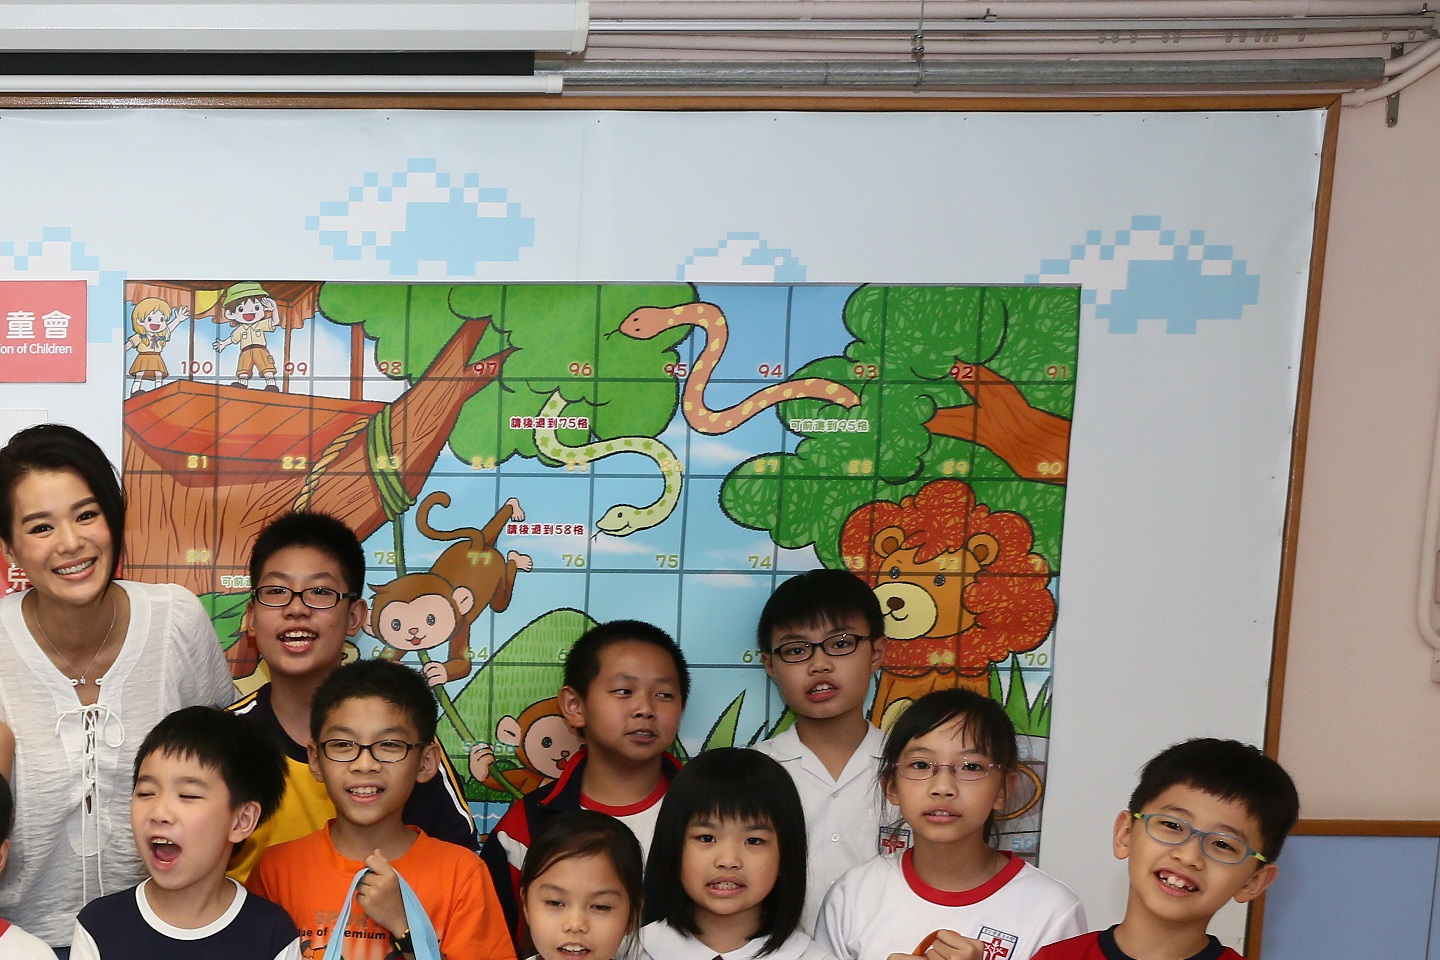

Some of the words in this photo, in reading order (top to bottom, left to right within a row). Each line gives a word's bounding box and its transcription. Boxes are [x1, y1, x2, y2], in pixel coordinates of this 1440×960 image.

[16, 342, 28, 354] of
[29, 342, 72, 354] Children
[181, 361, 213, 375] 100
[285, 361, 308, 375] 99
[378, 361, 402, 375] 98
[474, 362, 497, 376] 97
[569, 362, 593, 376] 96
[664, 363, 688, 377] 95
[759, 364, 782, 377] 94
[854, 364, 878, 378] 93
[949, 365, 973, 379] 92
[1047, 365, 1068, 379] 91
[510, 417, 589, 429] 請後退到75格
[187, 455, 208, 469] 81
[282, 456, 307, 470] 82
[376, 456, 400, 470] 83
[471, 456, 496, 471] 84
[564, 457, 590, 472] 85
[754, 459, 780, 474] 87
[848, 460, 873, 474] 88
[943, 461, 969, 475] 89
[1037, 462, 1062, 476] 90
[507, 524, 585, 536] 請後退到58格
[186, 549, 210, 563] 80
[373, 551, 397, 565] 78
[467, 552, 493, 567] 77
[562, 553, 585, 567] 76
[656, 554, 678, 568] 75
[748, 555, 772, 569] 74
[843, 556, 865, 570] 73
[936, 557, 960, 571] 72
[464, 646, 489, 661] 64
[1025, 652, 1048, 666] 70
[1011, 837, 1035, 850] 50
[317, 927, 328, 937] of
